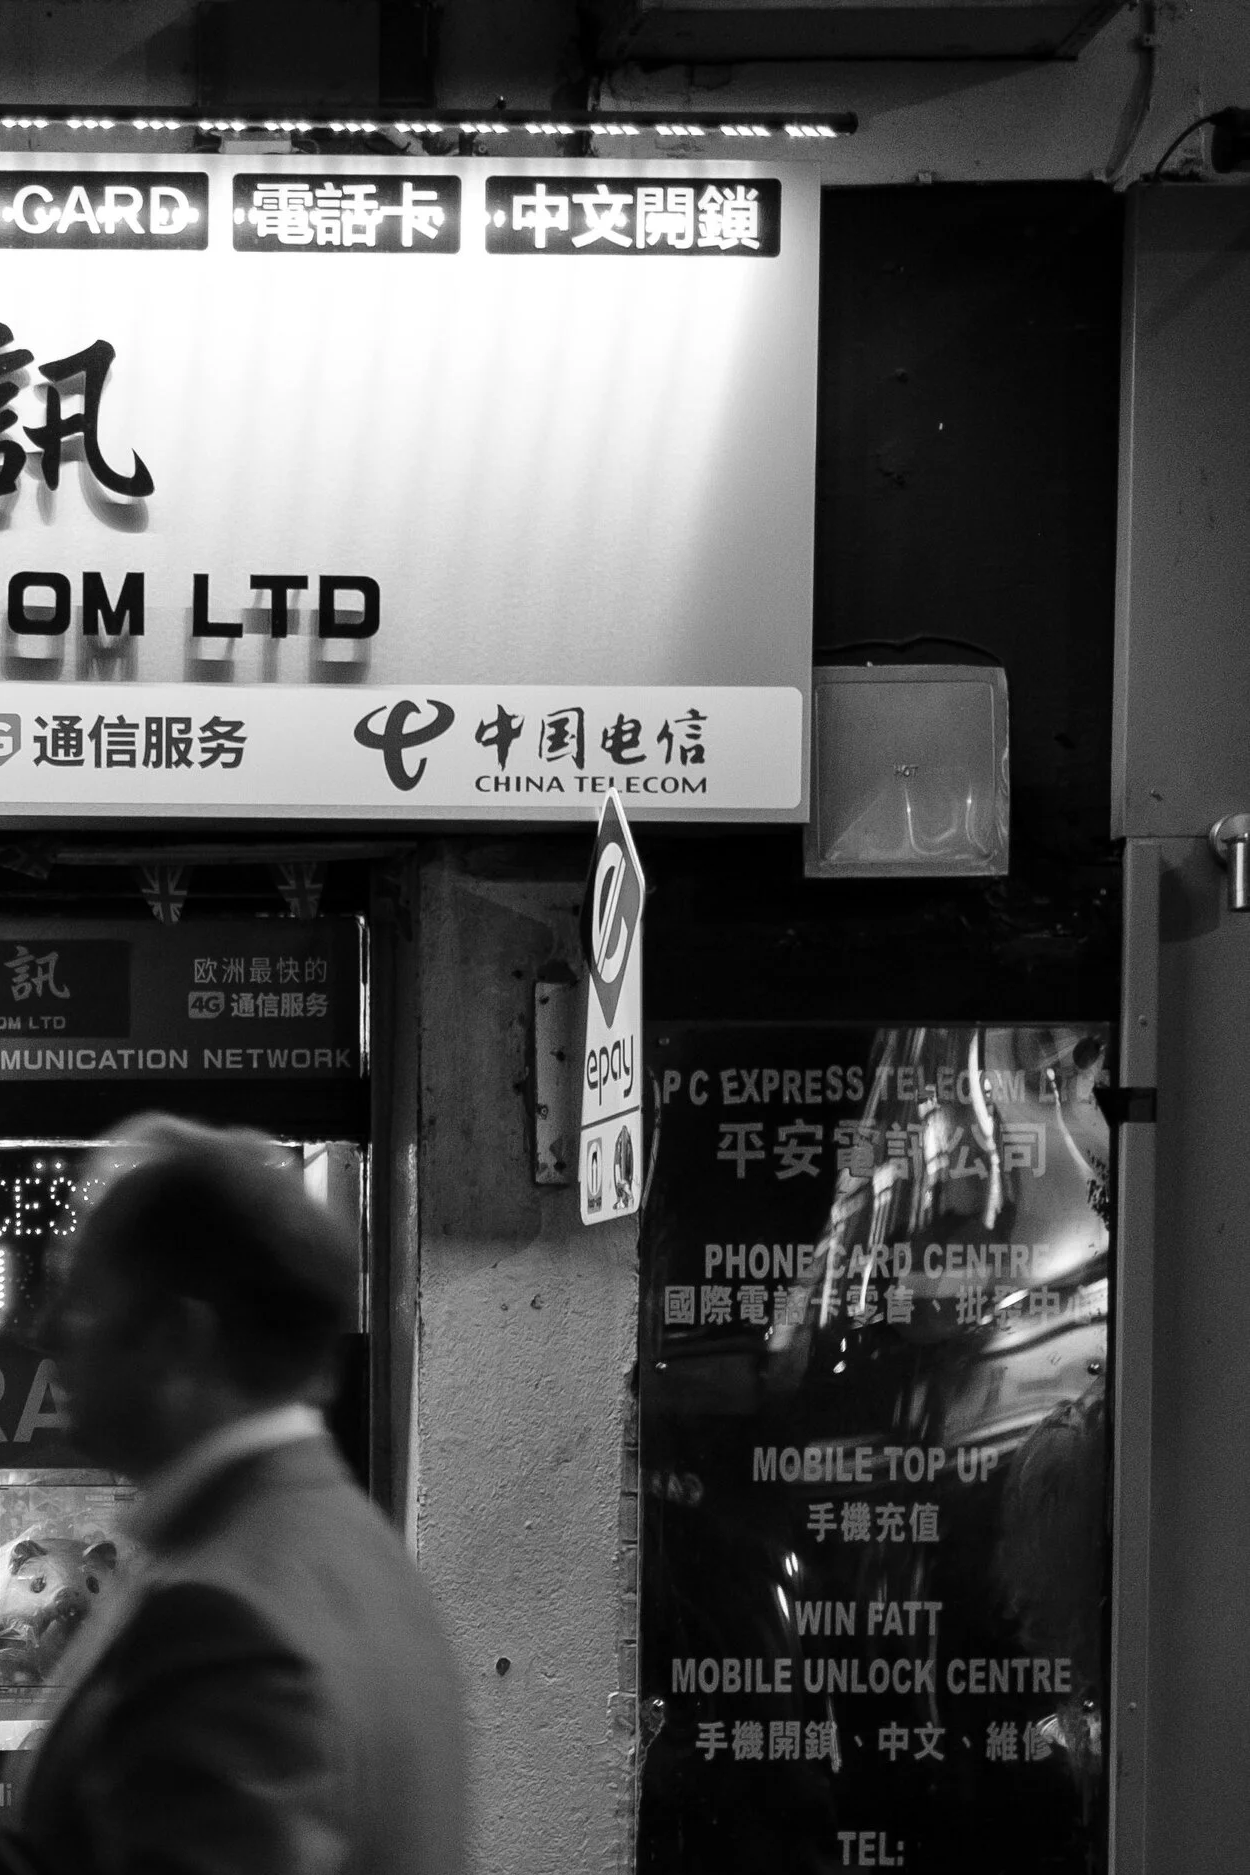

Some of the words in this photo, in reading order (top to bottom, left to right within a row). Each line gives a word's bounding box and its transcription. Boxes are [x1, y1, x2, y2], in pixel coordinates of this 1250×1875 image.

[11, 186, 193, 235] CARD
[252, 182, 441, 247] 電話卡
[511, 184, 761, 250] 中文開鎖
[193, 572, 382, 638] LTD
[32, 714, 249, 770] 通信服务
[473, 702, 709, 770] 中国电信
[475, 775, 564, 793] CHINA
[572, 776, 707, 794] TELECOM
[193, 956, 329, 985] 欧洲最快的
[28, 1016, 66, 1031] LTD
[190, 994, 223, 1016] 4G
[230, 991, 330, 1019] 通信服务
[203, 1048, 352, 1070] NETWORK
[586, 1034, 635, 1106] epay
[720, 1062, 866, 1105] EXPRESS
[705, 1243, 817, 1280] PHONE
[752, 1446, 873, 1483] MOBILE
[883, 1446, 946, 1483] TOP
[957, 1446, 999, 1483] UP
[807, 1501, 941, 1543] 手機充值
[795, 1600, 856, 1637] WIN
[866, 1600, 943, 1637] FATT
[670, 1658, 792, 1695] MOBILE
[803, 1658, 935, 1695] UNLOCK
[946, 1657, 1072, 1695] CENTRE
[837, 1831, 905, 1867] TEL:
